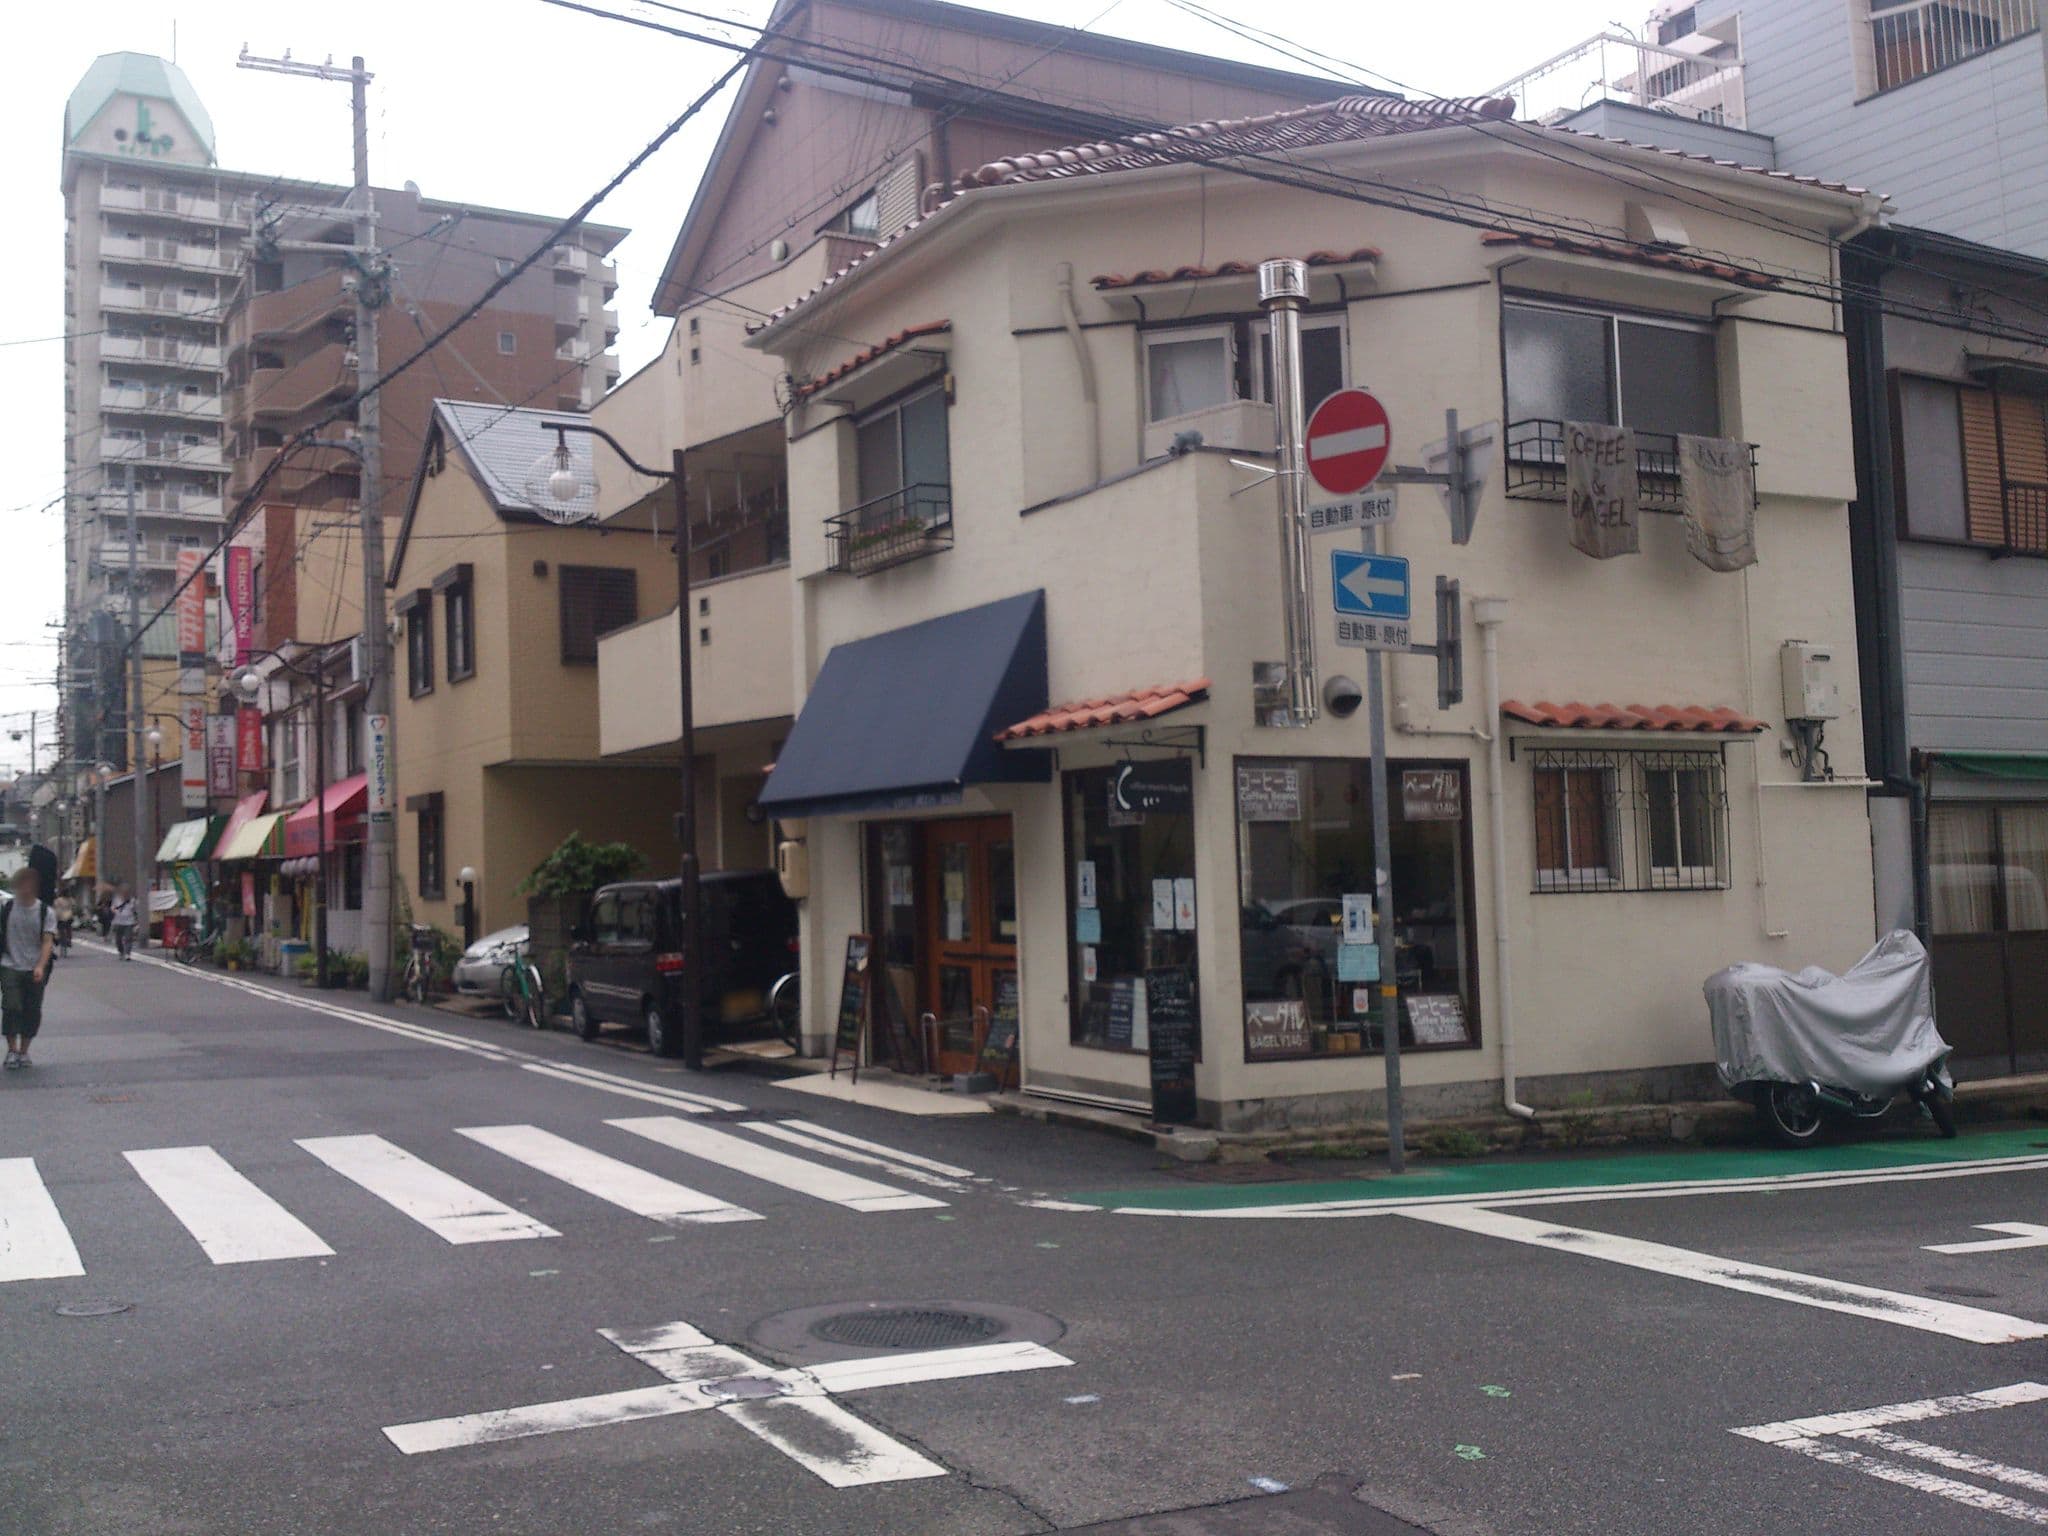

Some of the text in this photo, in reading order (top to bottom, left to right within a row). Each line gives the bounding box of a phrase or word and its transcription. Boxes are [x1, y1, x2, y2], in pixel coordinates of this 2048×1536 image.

[1569, 428, 1626, 465] OFFEE
[1571, 488, 1631, 528] BAGEL
[1239, 771, 1297, 792] コーヒー豆
[1405, 772, 1458, 801] ベーグル
[1247, 1002, 1306, 1033] ベーグル
[1406, 996, 1463, 1016] コーヒー豆
[1249, 1034, 1281, 1048] BAGEL
